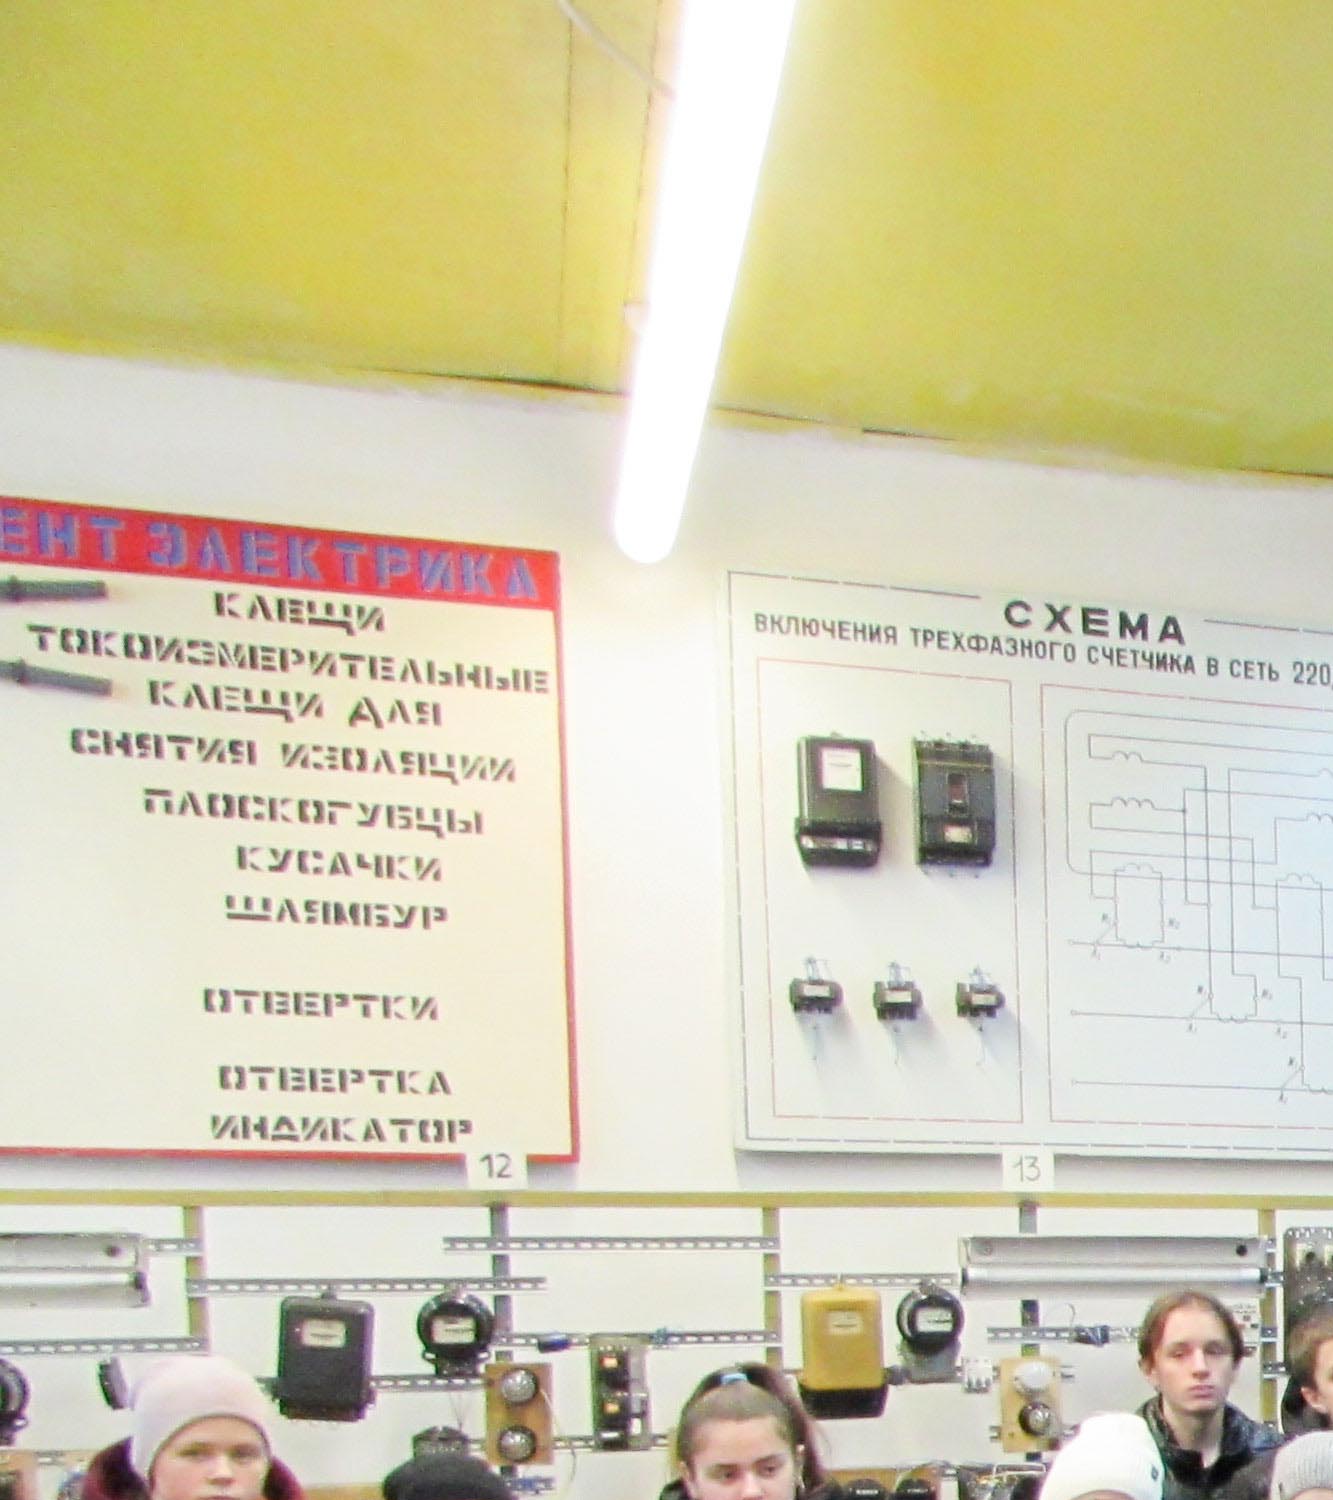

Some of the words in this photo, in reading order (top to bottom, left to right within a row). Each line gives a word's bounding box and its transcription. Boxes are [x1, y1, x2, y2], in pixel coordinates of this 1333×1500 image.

[148, 521, 539, 598] ЭЛЕКТРИКА
[214, 591, 386, 635] КЛЕЩИ
[1004, 600, 1186, 645] СХЕМА
[27, 624, 550, 694] ТОКОИЗМЕРИТЕЛЬНЫЕ
[753, 612, 898, 645] ВКЛЮЧЕНИЯ
[909, 627, 1077, 663] ТРЕХФАЗНОГО
[1087, 646, 1196, 674] СЧЕТЧИКА
[1206, 657, 1219, 677] В
[1229, 659, 1280, 682] СЕТЬ
[148, 679, 324, 722] КЛЕЩИ
[349, 696, 443, 728] ДЛЯ
[71, 727, 257, 766] СНЯТИЯ
[281, 742, 517, 784] ИЗОЛЯЦИИ
[144, 788, 484, 838] ПЛОСКОГУБЦЫ
[236, 845, 443, 881] КУСАЧКИ
[225, 895, 448, 930] ШЛЯМБУР
[203, 988, 440, 1021] ОТВЕРТКИ
[218, 1065, 453, 1096] ОТВЕРТКА
[210, 1115, 474, 1143] ИНДИКАТОР
[479, 1153, 512, 1178] 12
[1013, 1155, 1041, 1182] 13
